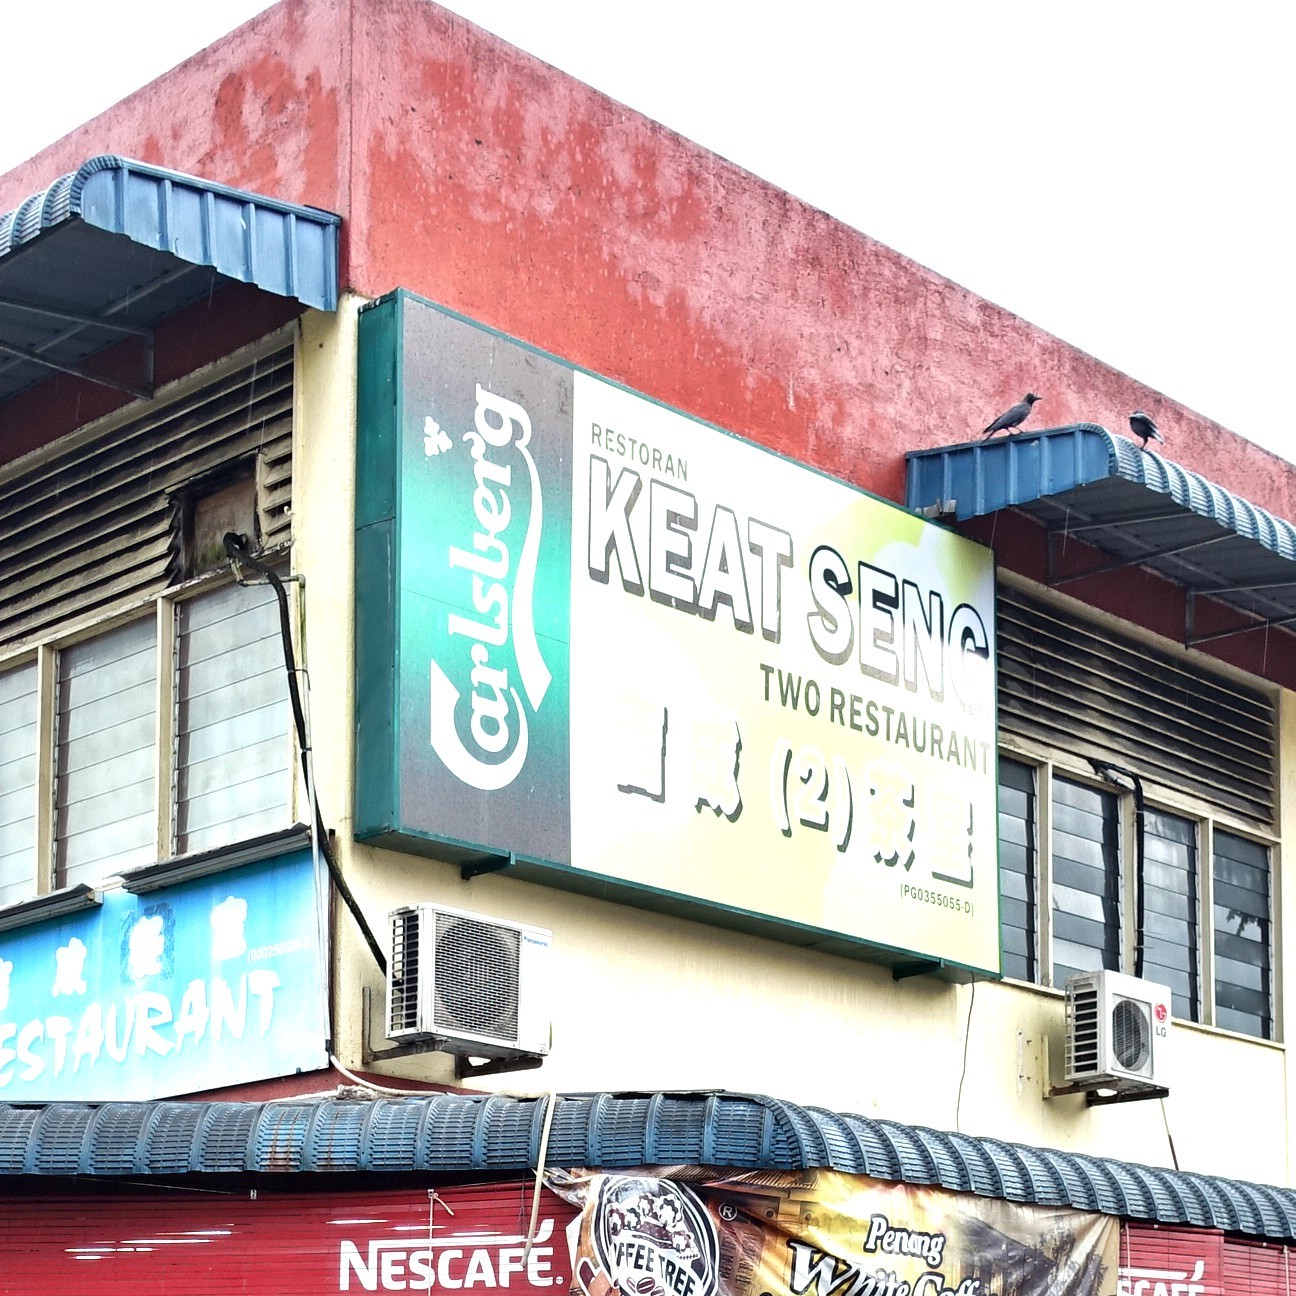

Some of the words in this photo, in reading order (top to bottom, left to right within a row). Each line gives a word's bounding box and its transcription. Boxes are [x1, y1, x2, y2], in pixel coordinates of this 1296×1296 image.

[590, 421, 688, 482] RESTORAN
[587, 454, 793, 643] KEAT
[430, 383, 552, 791] Carlsberg
[759, 664, 820, 717] TWO
[829, 689, 990, 776] RESTAURANT
[900, 883, 974, 917] (PG0355055-D)
[1156, 1026, 1166, 1037] LG
[339, 1218, 565, 1293] NESCAFÉ
[865, 1213, 946, 1268] Penang
